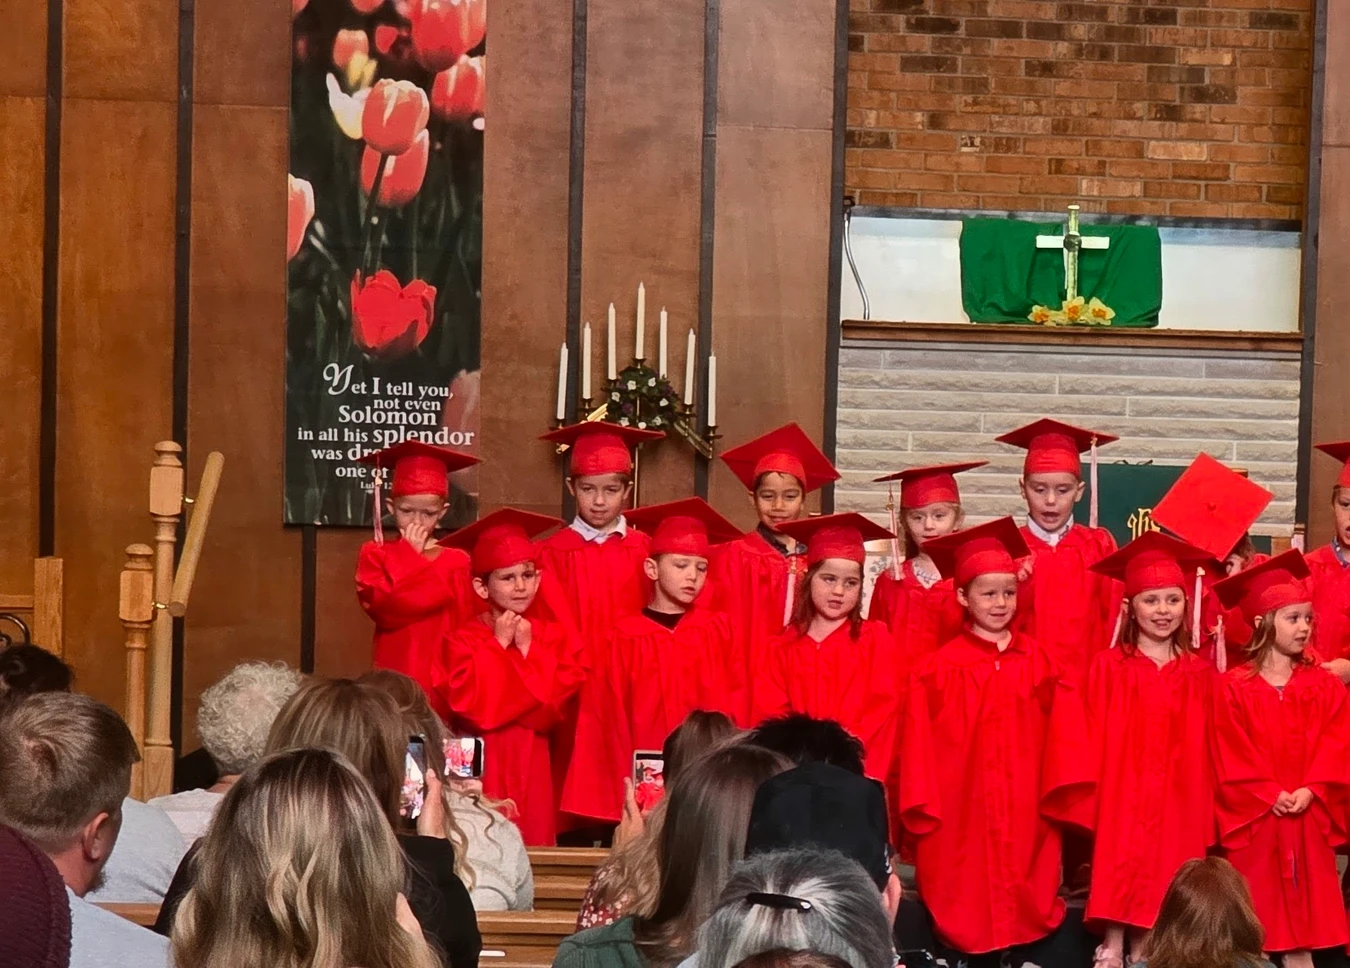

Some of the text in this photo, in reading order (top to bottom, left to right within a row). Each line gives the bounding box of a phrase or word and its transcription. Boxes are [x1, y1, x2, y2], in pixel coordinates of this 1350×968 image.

[322, 362, 454, 400] Yet I tell you,
[373, 398, 442, 411] not even
[338, 405, 437, 426] Solomon
[297, 426, 475, 447] in all his splendor
[311, 449, 343, 461] was
[335, 466, 367, 479] one
